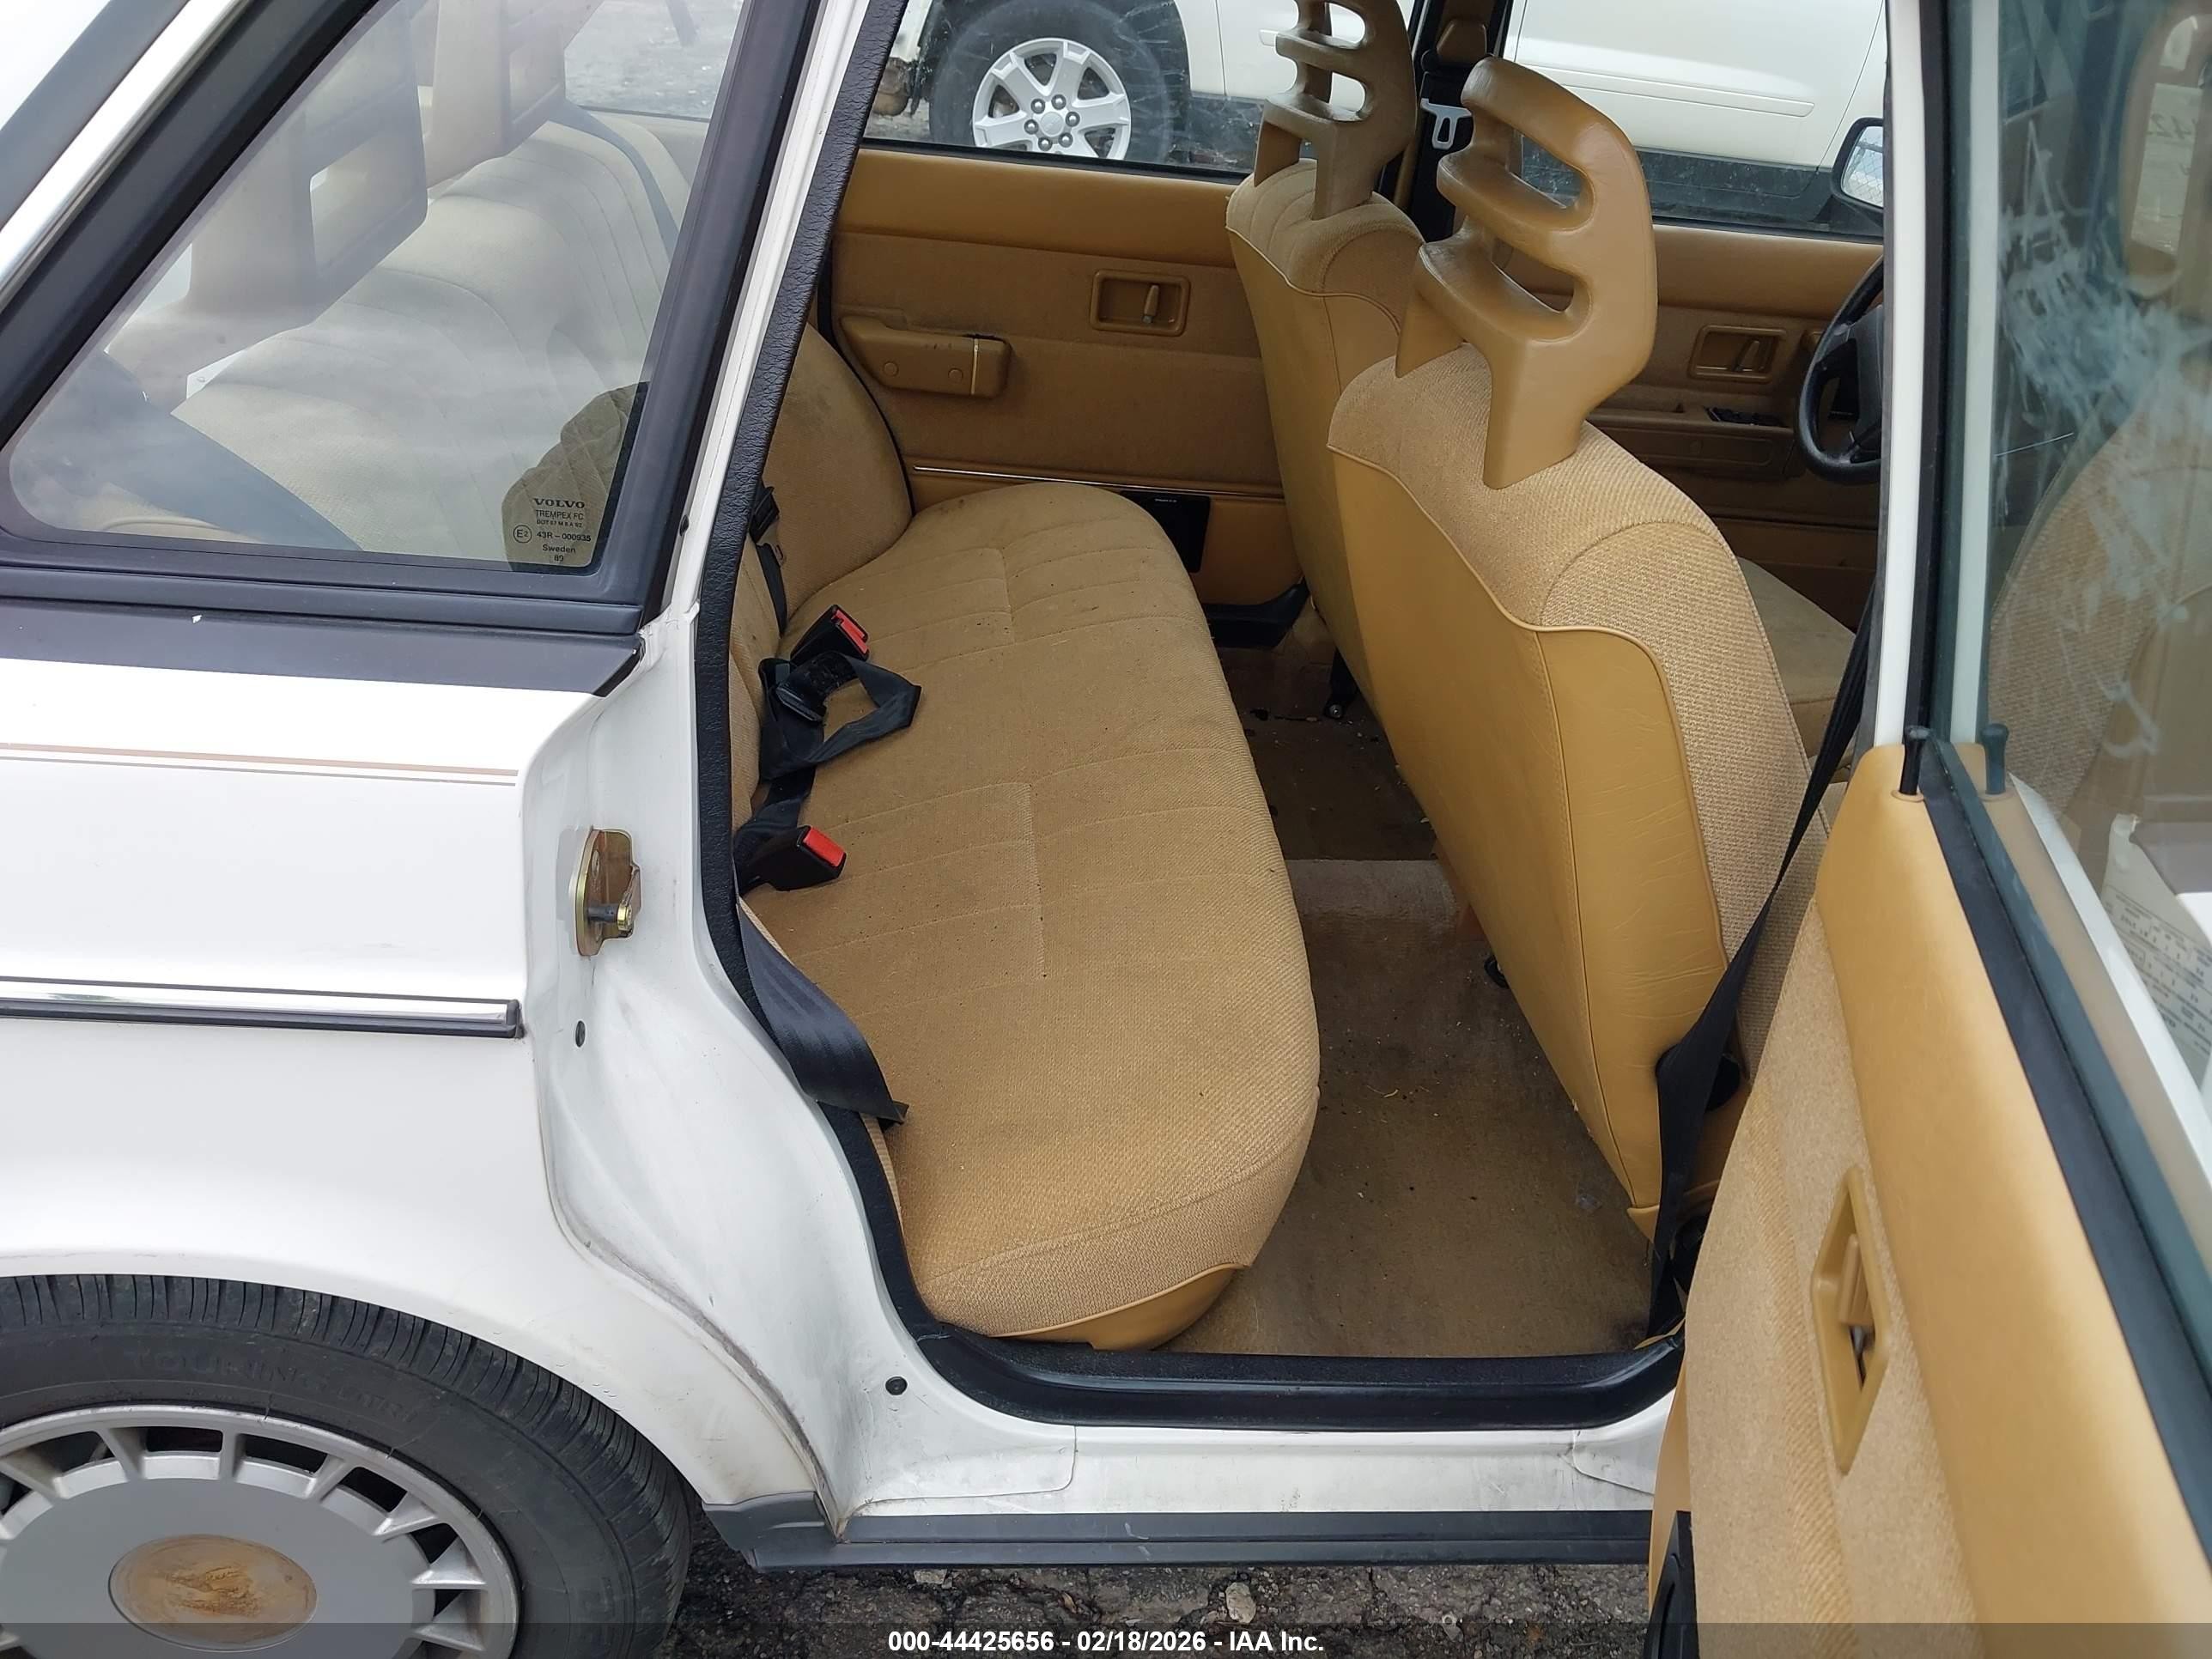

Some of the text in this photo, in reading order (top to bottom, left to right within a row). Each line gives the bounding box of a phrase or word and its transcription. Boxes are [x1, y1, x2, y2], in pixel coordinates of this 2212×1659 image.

[534, 498, 585, 508] VOLVO
[536, 509, 572, 520] TREMPEX
[542, 544, 576, 554] Sweden
